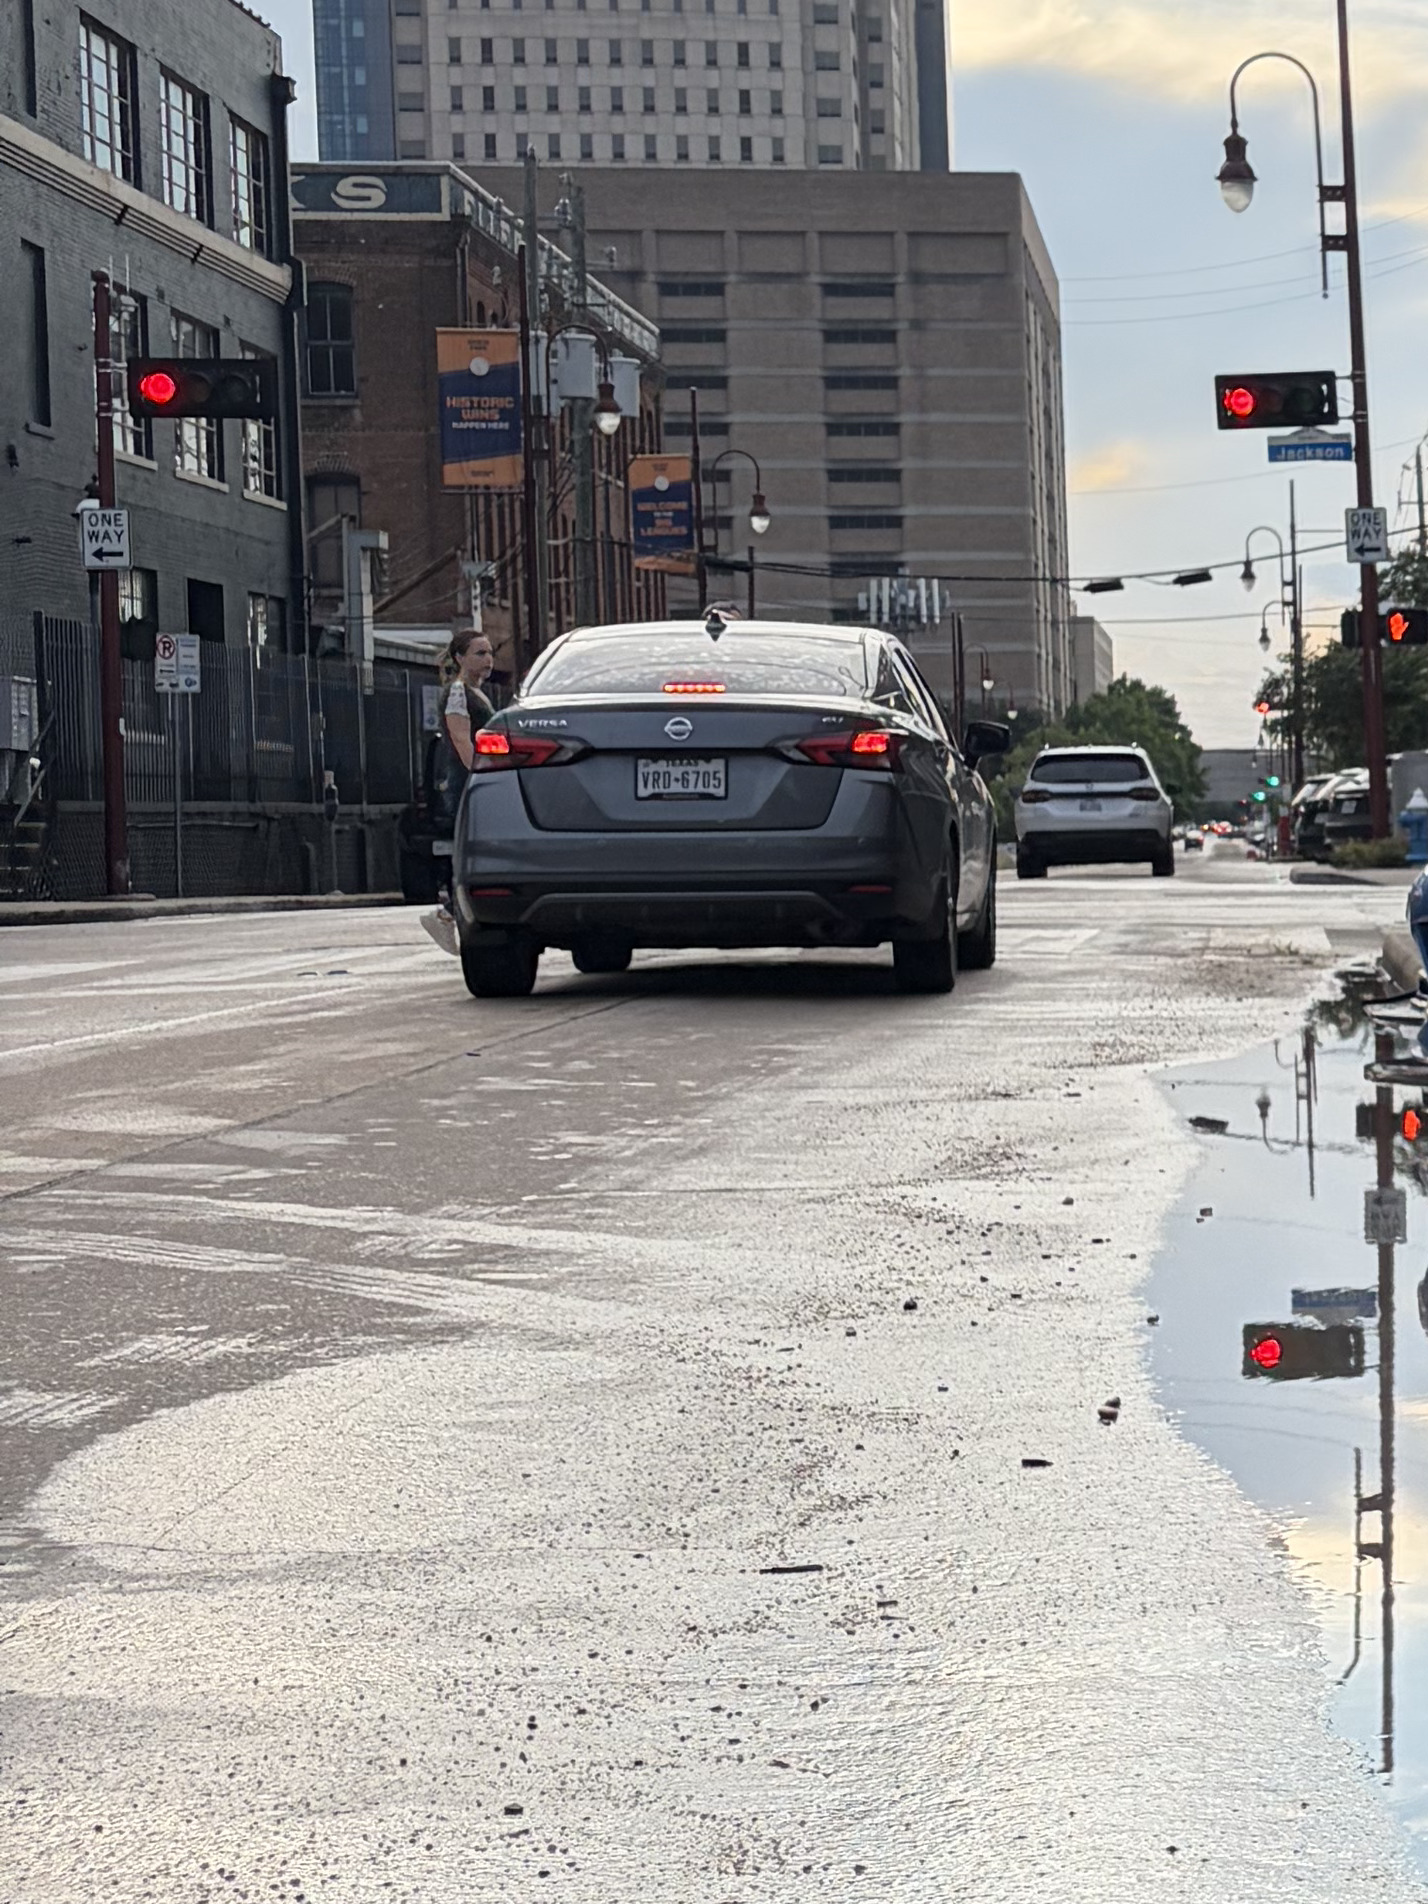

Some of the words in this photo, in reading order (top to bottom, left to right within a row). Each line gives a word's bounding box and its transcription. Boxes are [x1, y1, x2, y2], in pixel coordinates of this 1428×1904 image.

[446, 396, 515, 409] HISTORIC
[461, 408, 501, 421] WINS
[1276, 446, 1345, 460] Jackson
[88, 513, 124, 527] ONE
[1350, 513, 1381, 525] ONE
[87, 530, 124, 544] WAY
[1351, 528, 1382, 541] WAY
[517, 719, 568, 728] VERSA
